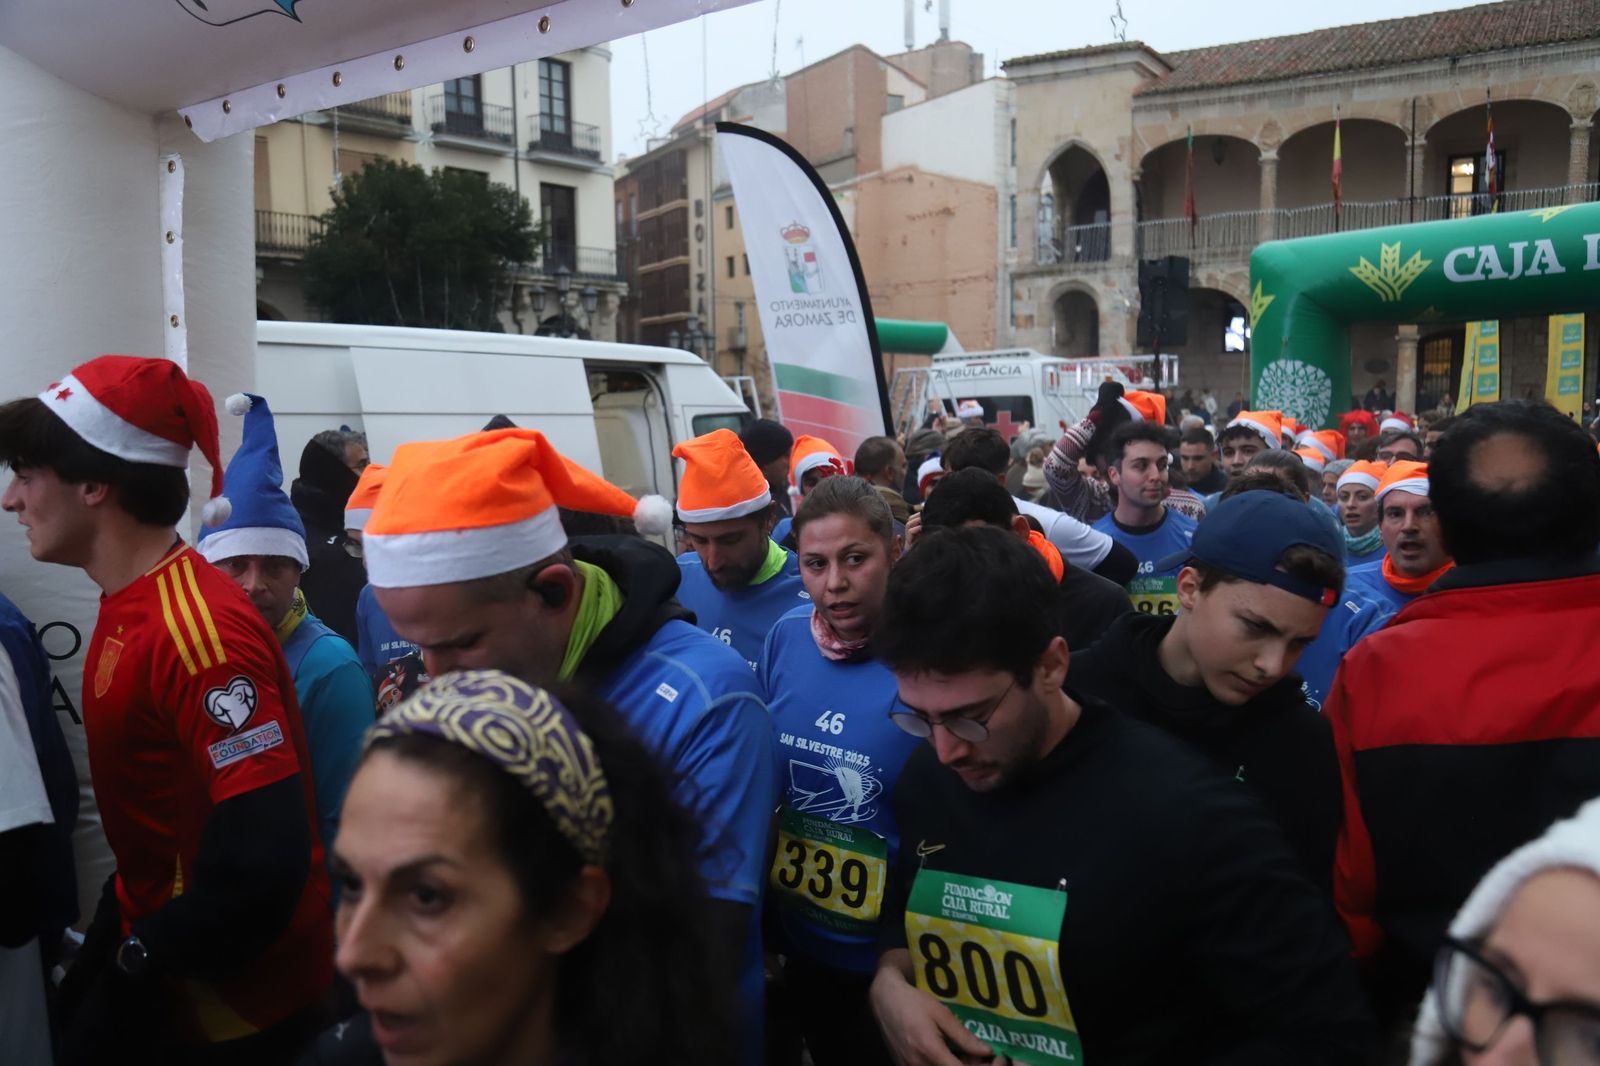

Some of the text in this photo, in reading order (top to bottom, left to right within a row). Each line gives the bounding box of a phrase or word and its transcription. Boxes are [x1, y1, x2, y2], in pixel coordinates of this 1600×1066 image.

[1443, 238, 1566, 283] CAJA
[934, 364, 1022, 380] AMBULANCIA
[1137, 561, 1154, 574] 46
[38, 621, 82, 661] O
[51, 674, 83, 725] A
[815, 710, 846, 735] 46
[212, 728, 280, 759] FOUNDATION
[780, 732, 871, 767] SAN SILVESTRE 2025
[778, 839, 868, 909] 339
[942, 894, 1011, 920] CAJA RURAL
[918, 933, 1048, 1018] 800
[964, 1018, 1075, 1061] CAJA RURAL
